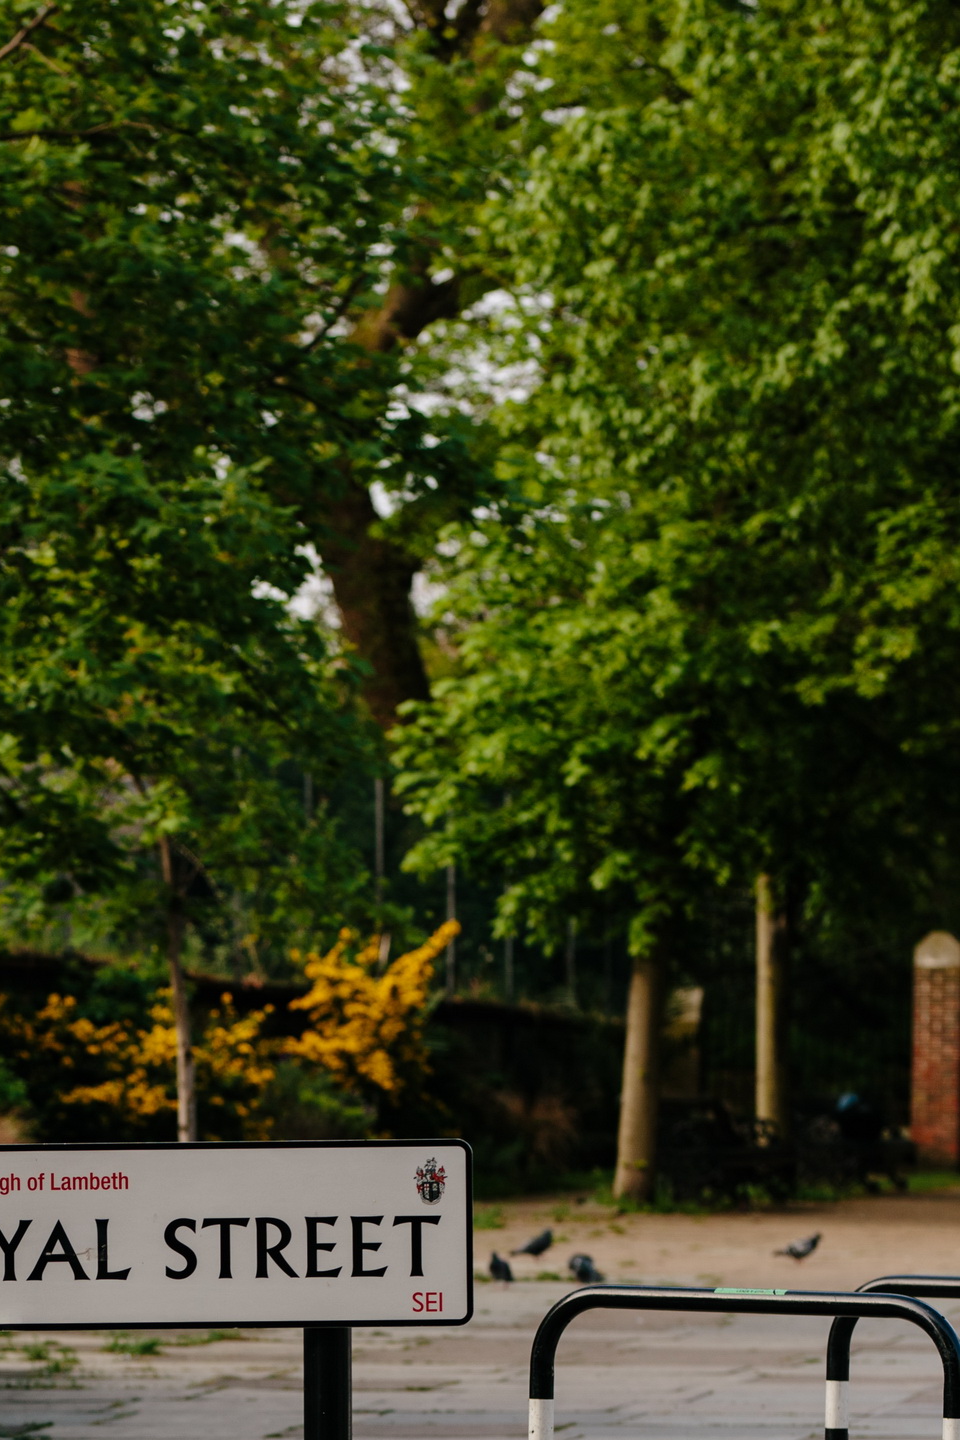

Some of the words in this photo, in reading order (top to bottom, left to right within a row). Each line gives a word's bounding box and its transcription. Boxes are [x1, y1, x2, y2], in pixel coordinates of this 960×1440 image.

[27, 1173, 44, 1191] of
[50, 1172, 128, 1191] Lambeth
[164, 1216, 441, 1279] STREET
